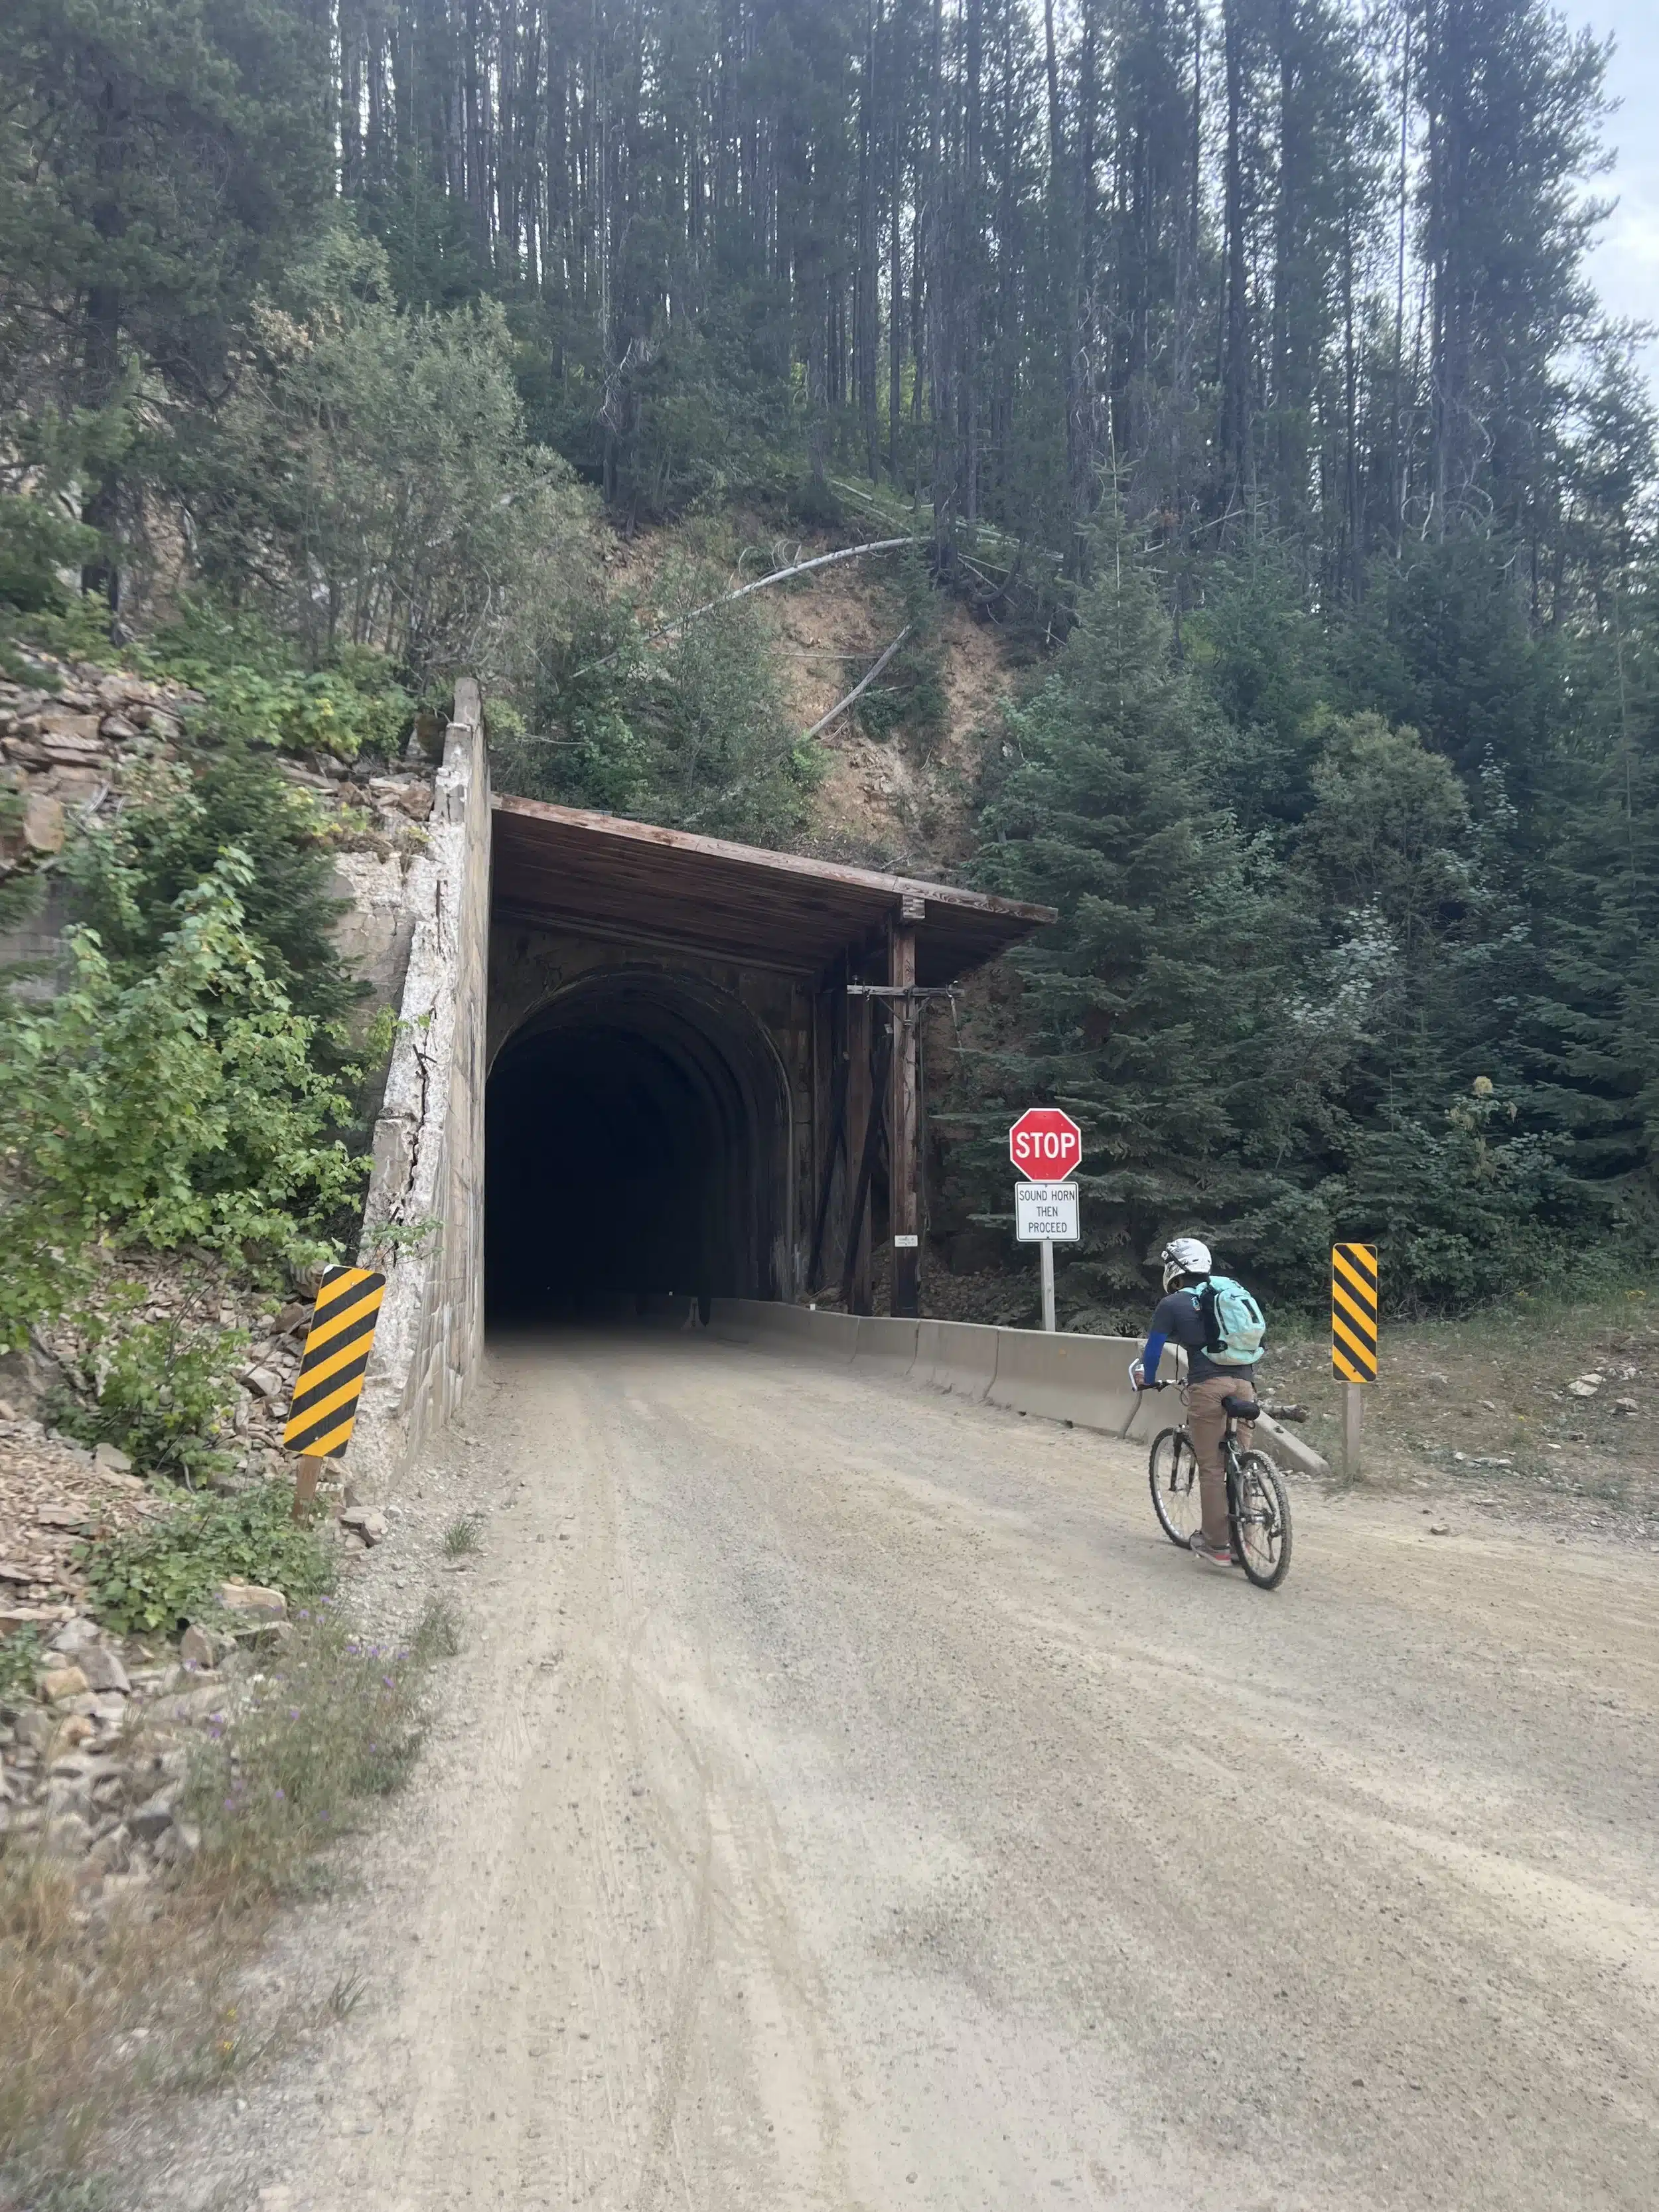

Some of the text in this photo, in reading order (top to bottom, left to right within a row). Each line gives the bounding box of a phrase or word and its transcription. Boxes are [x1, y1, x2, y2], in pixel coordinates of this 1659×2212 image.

[1015, 1132, 1076, 1159] STOP
[1019, 1190, 1075, 1201] SOUND HORN
[1037, 1206, 1058, 1217] THEN
[1029, 1222, 1067, 1233] PROCEED
